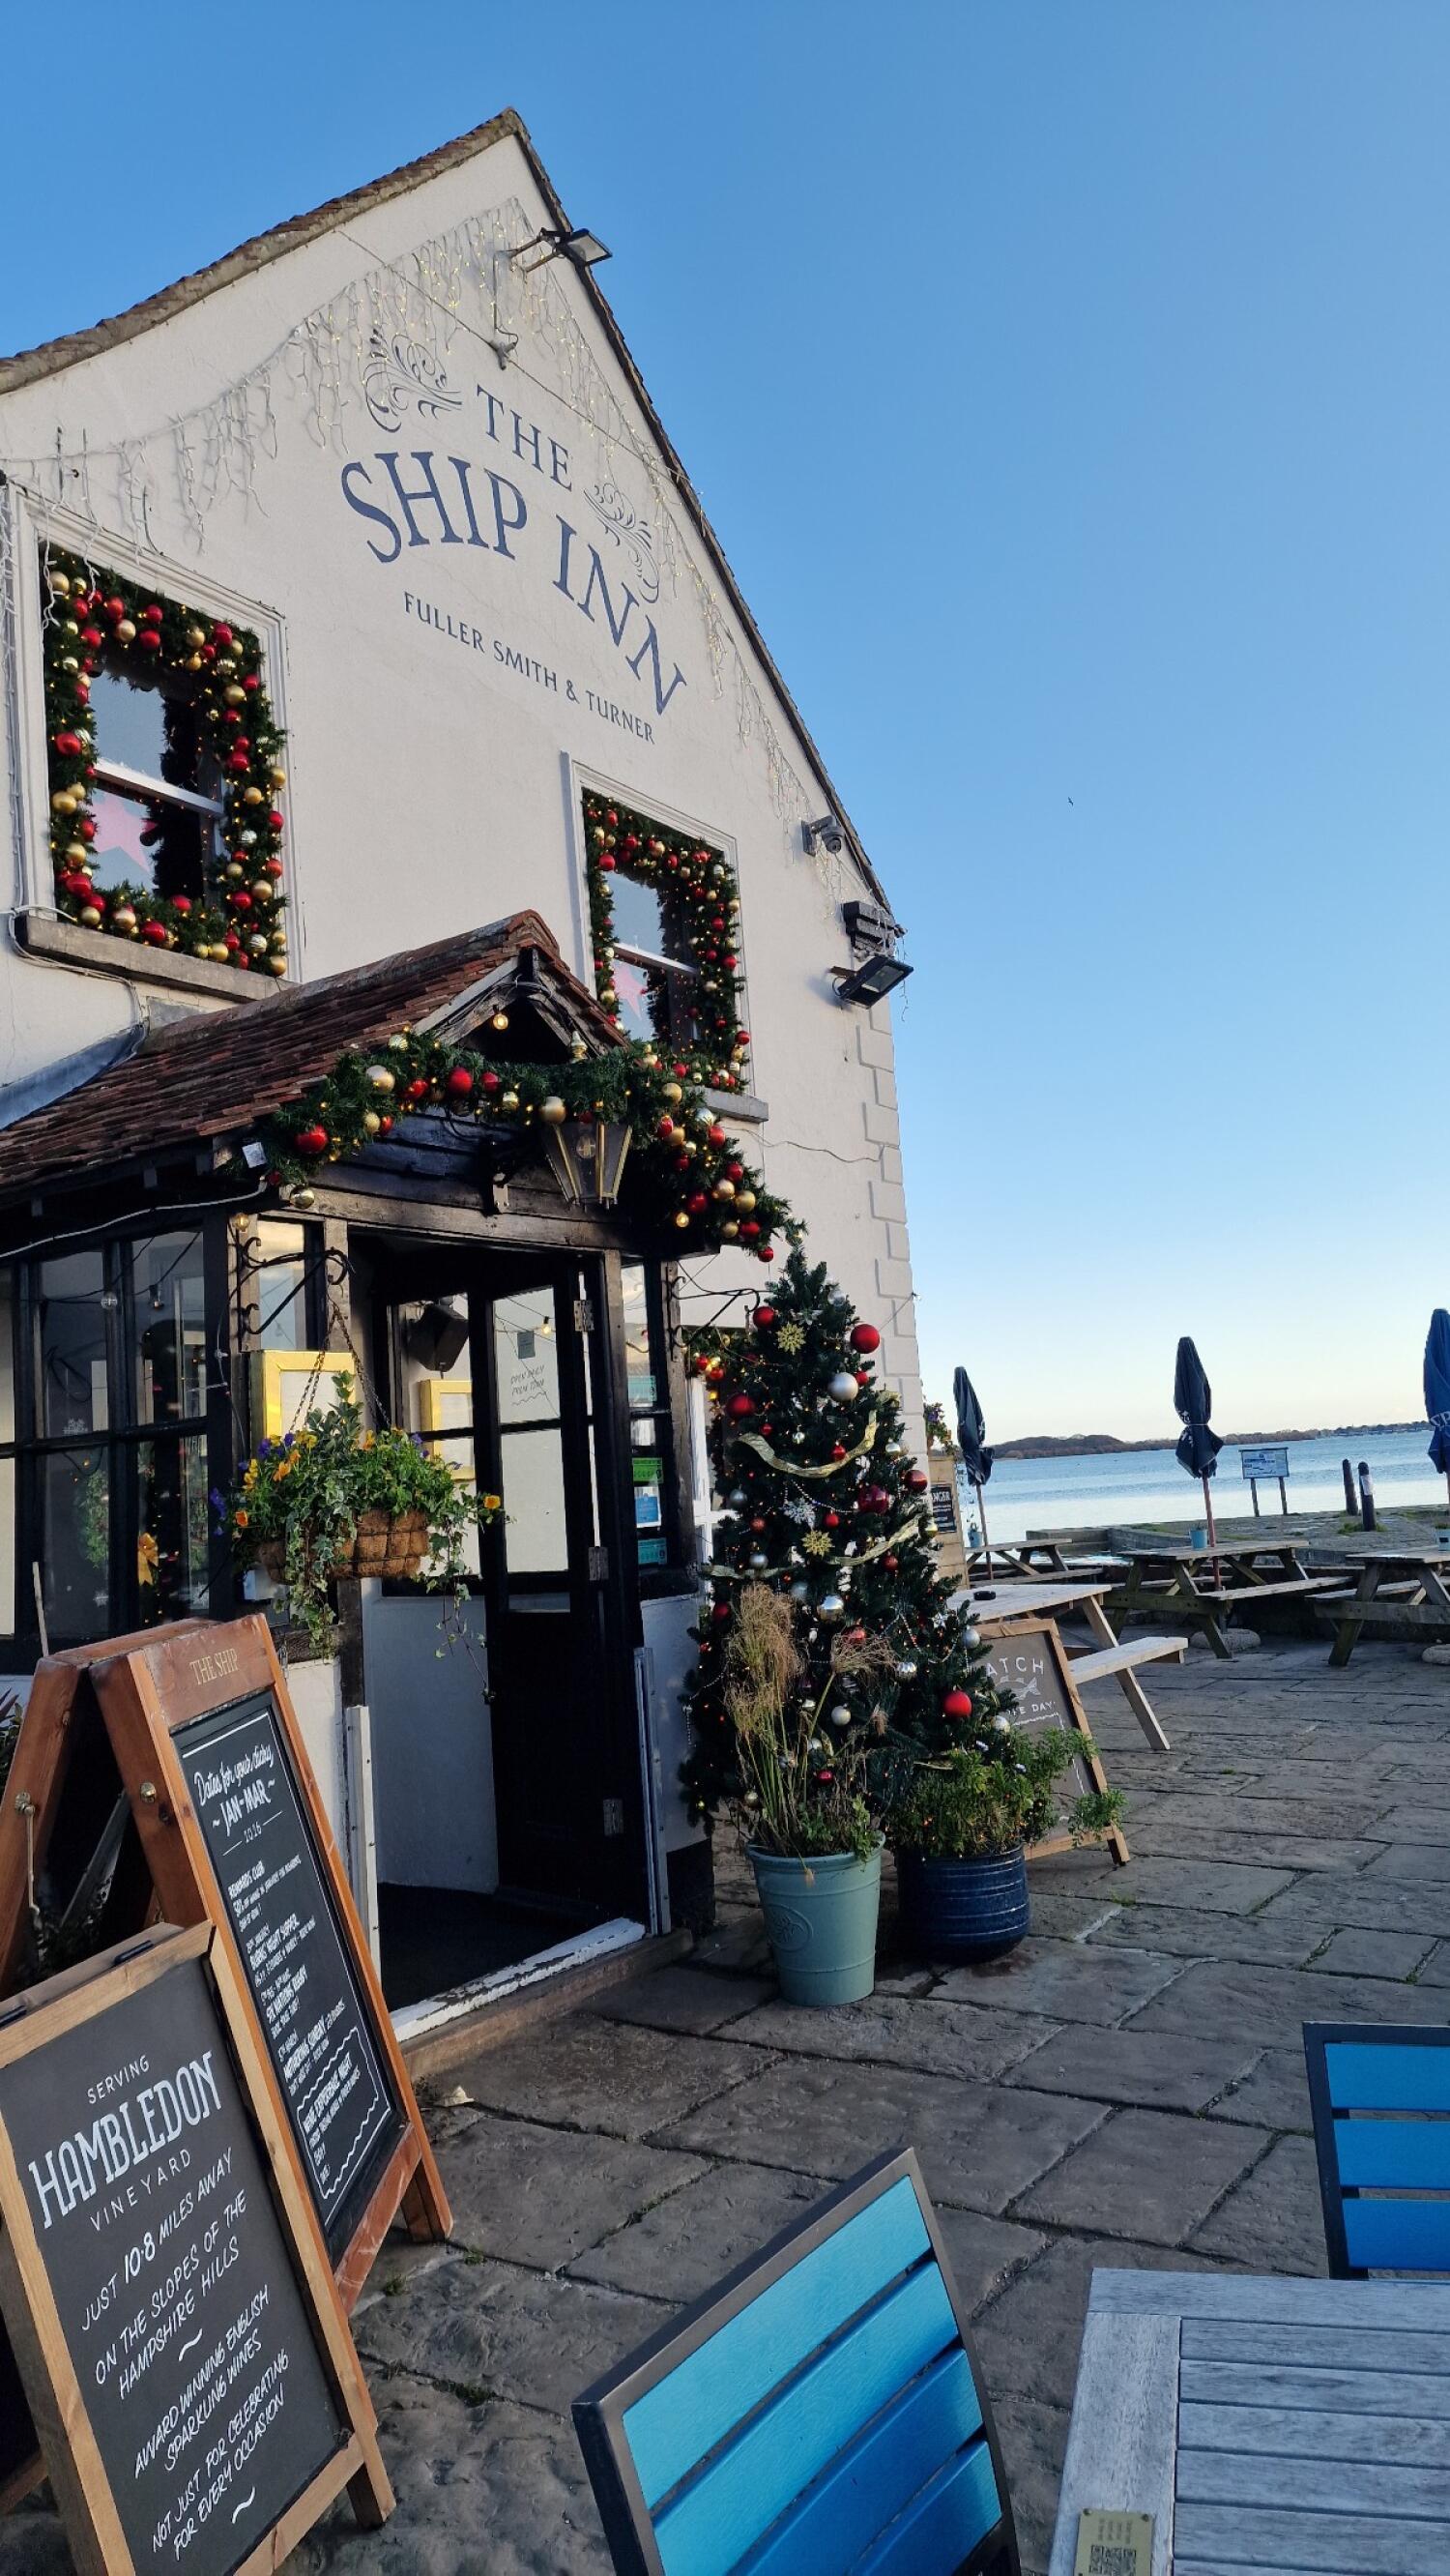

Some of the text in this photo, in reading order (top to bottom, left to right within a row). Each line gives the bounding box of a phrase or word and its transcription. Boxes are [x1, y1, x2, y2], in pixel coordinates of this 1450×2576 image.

[477, 385, 572, 490] THE
[341, 452, 686, 715] SHIP INN
[404, 591, 654, 744] FULLER SMITH & TURNER
[189, 1648, 240, 1686] THE SHIP
[984, 1656, 1044, 1678] ATCH
[194, 1771, 222, 1806] Dates
[28, 2050, 222, 2229] HAMBLEDON
[88, 2055, 150, 2104] SERVING
[82, 2273, 118, 2330] JUST
[159, 2192, 194, 2244] MILES
[197, 2147, 233, 2202] AWAY
[90, 2149, 190, 2232] VINEYARD
[96, 2189, 246, 2386] ON THE SLOPES OF THE
[119, 2236, 240, 2399] HAMPSHIRE HILLS
[134, 2284, 269, 2479] AWARD WINNING ENGLISH
[153, 2353, 289, 2553] NOT JUST FOR CELEBRATING
[164, 2328, 263, 2472] SPARKLING WINES
[174, 2383, 284, 2561] FOR EVERY OCCASION
